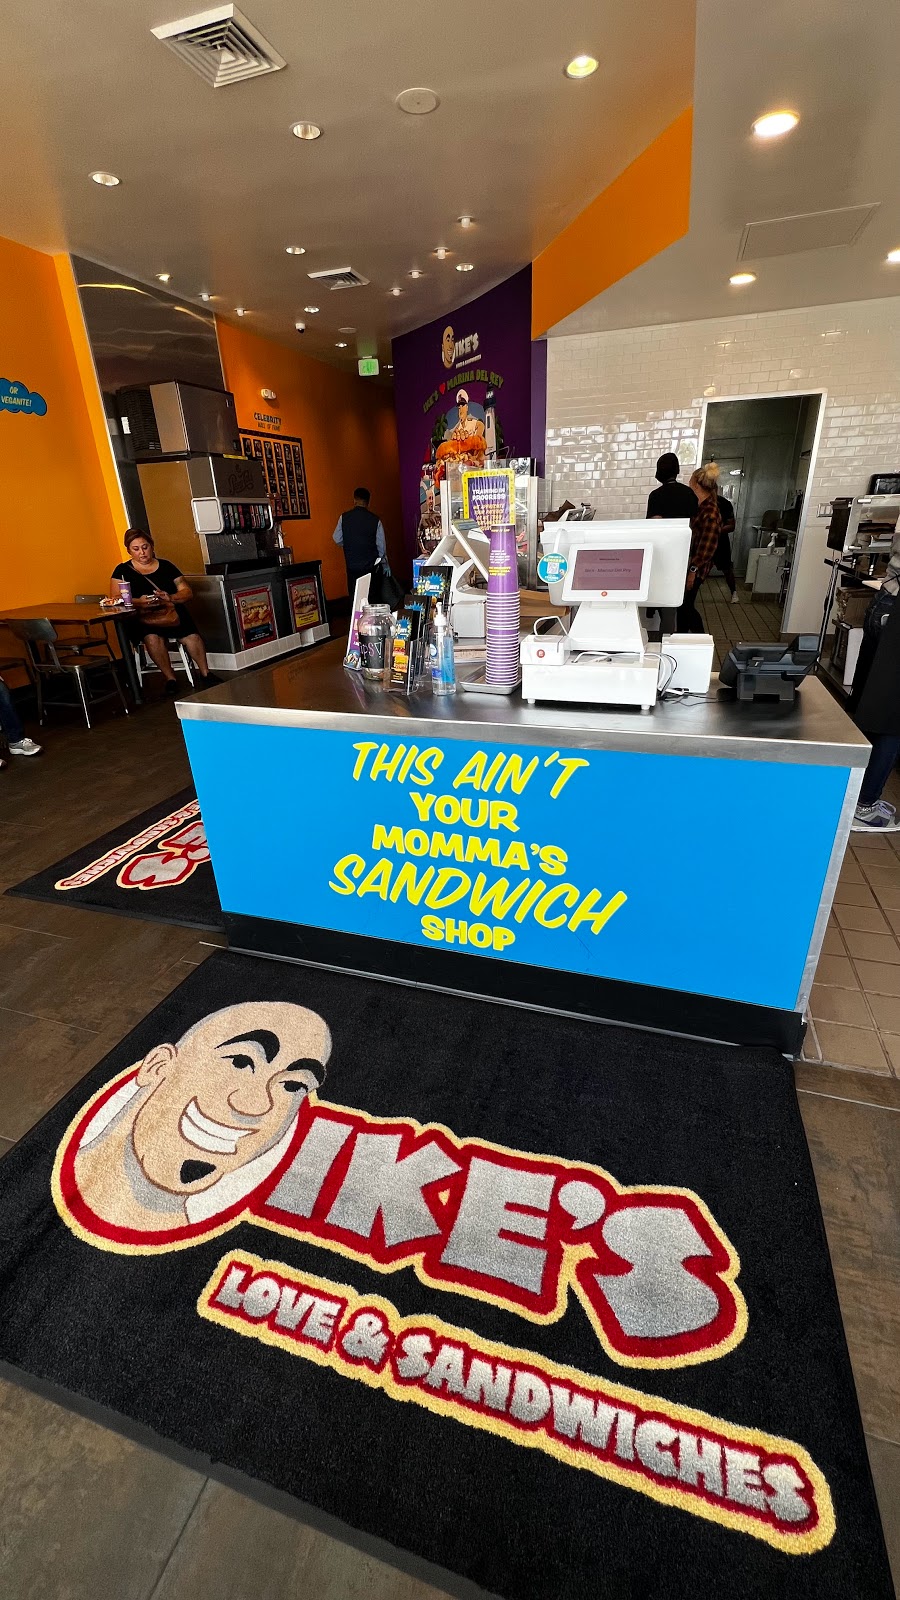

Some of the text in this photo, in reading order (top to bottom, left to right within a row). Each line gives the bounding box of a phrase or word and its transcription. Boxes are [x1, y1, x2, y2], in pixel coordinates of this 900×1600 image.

[455, 332, 479, 358] IKE'S
[9, 386, 19, 395] OR
[447, 370, 475, 390] MARINA
[476, 369, 489, 382] DEL
[490, 371, 504, 389] REY
[1, 396, 32, 407] VEGANITE!
[254, 411, 282, 426] CELEBRITY
[352, 742, 590, 799] THIS AIN'T
[409, 791, 520, 832] YOUR
[372, 824, 569, 876] MOMMA'S
[328, 854, 628, 935] SANDWICH
[420, 914, 516, 951] SHOP
[265, 1116, 720, 1340] IKE'S
[213, 1264, 812, 1522] LOVE & SANDWICHES
